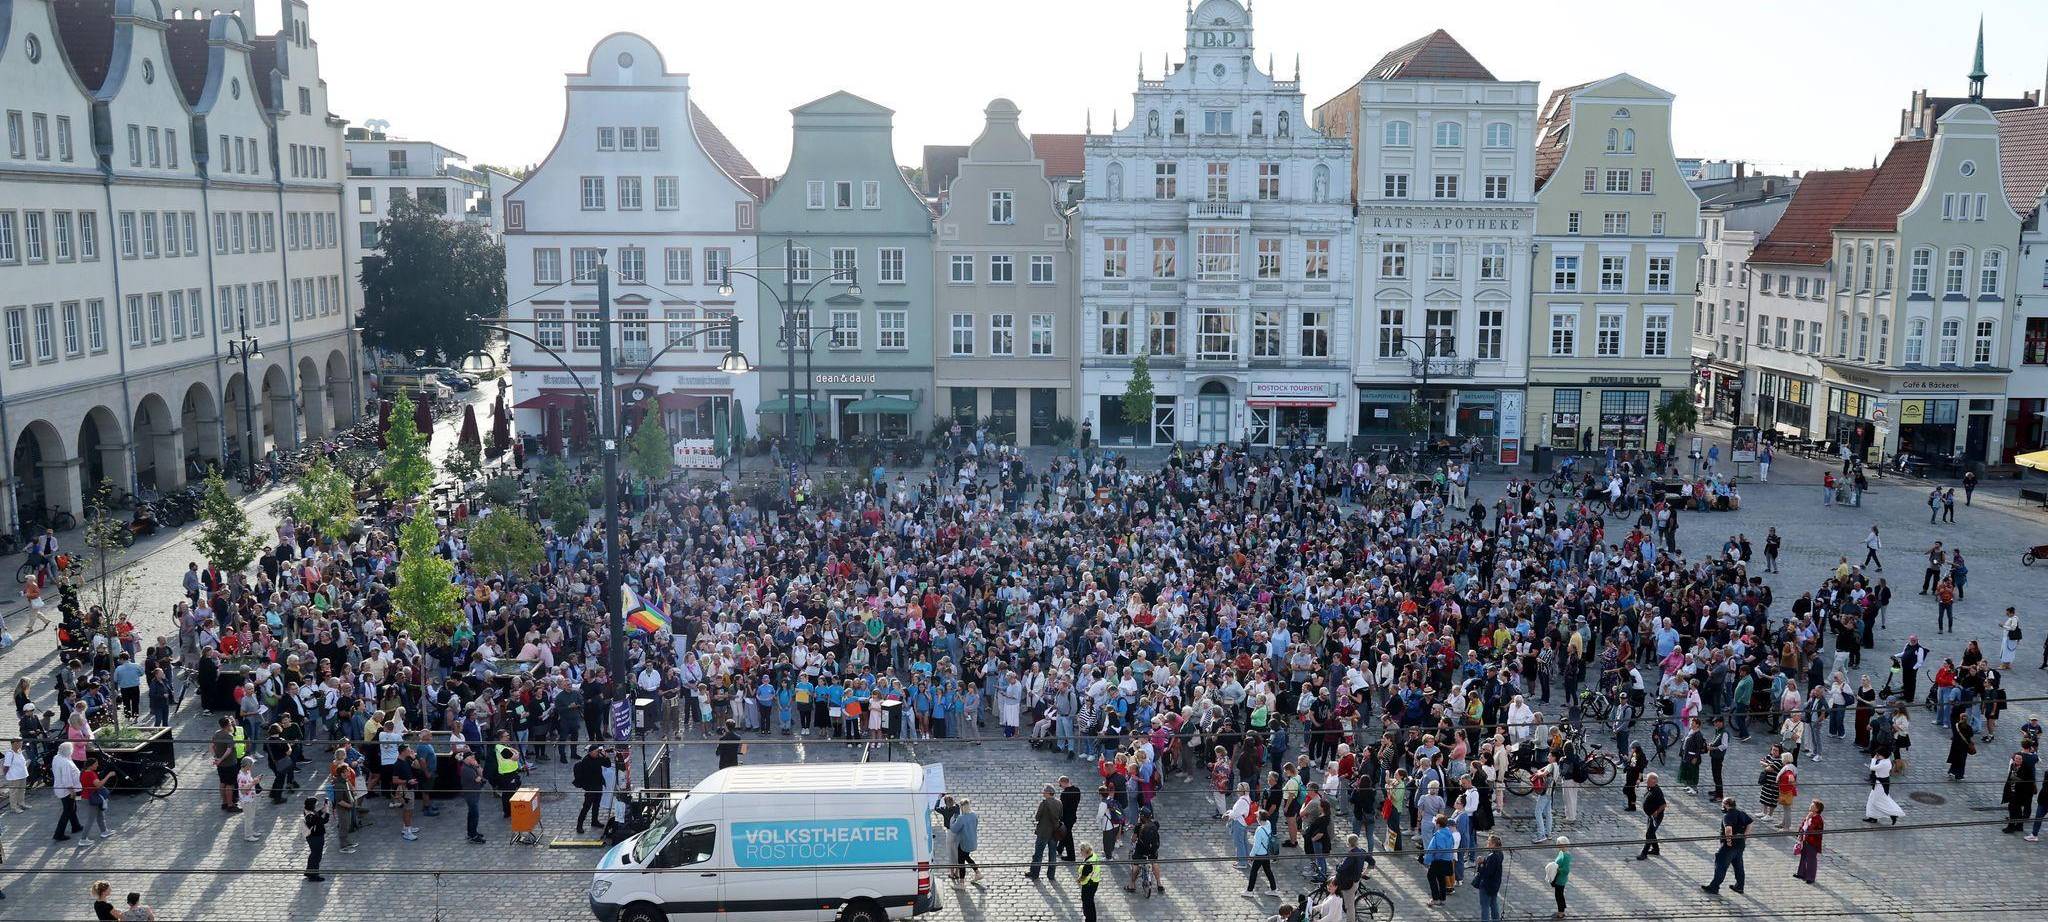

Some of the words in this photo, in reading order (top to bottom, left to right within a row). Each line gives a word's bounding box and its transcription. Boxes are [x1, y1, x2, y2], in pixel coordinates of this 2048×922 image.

[1373, 217, 1413, 228] RATS
[1433, 218, 1520, 230] APOTHEKE
[816, 374, 839, 383] dean
[840, 373, 848, 383] &
[849, 374, 876, 383] david
[1588, 376, 1634, 384] JUWELIER
[1636, 376, 1662, 384] WITT
[1902, 380, 1920, 389] Café
[1928, 381, 1960, 389] Bäckerei
[745, 826, 898, 844] VOLKSTHEATER
[746, 843, 839, 860] ROSTOCK
